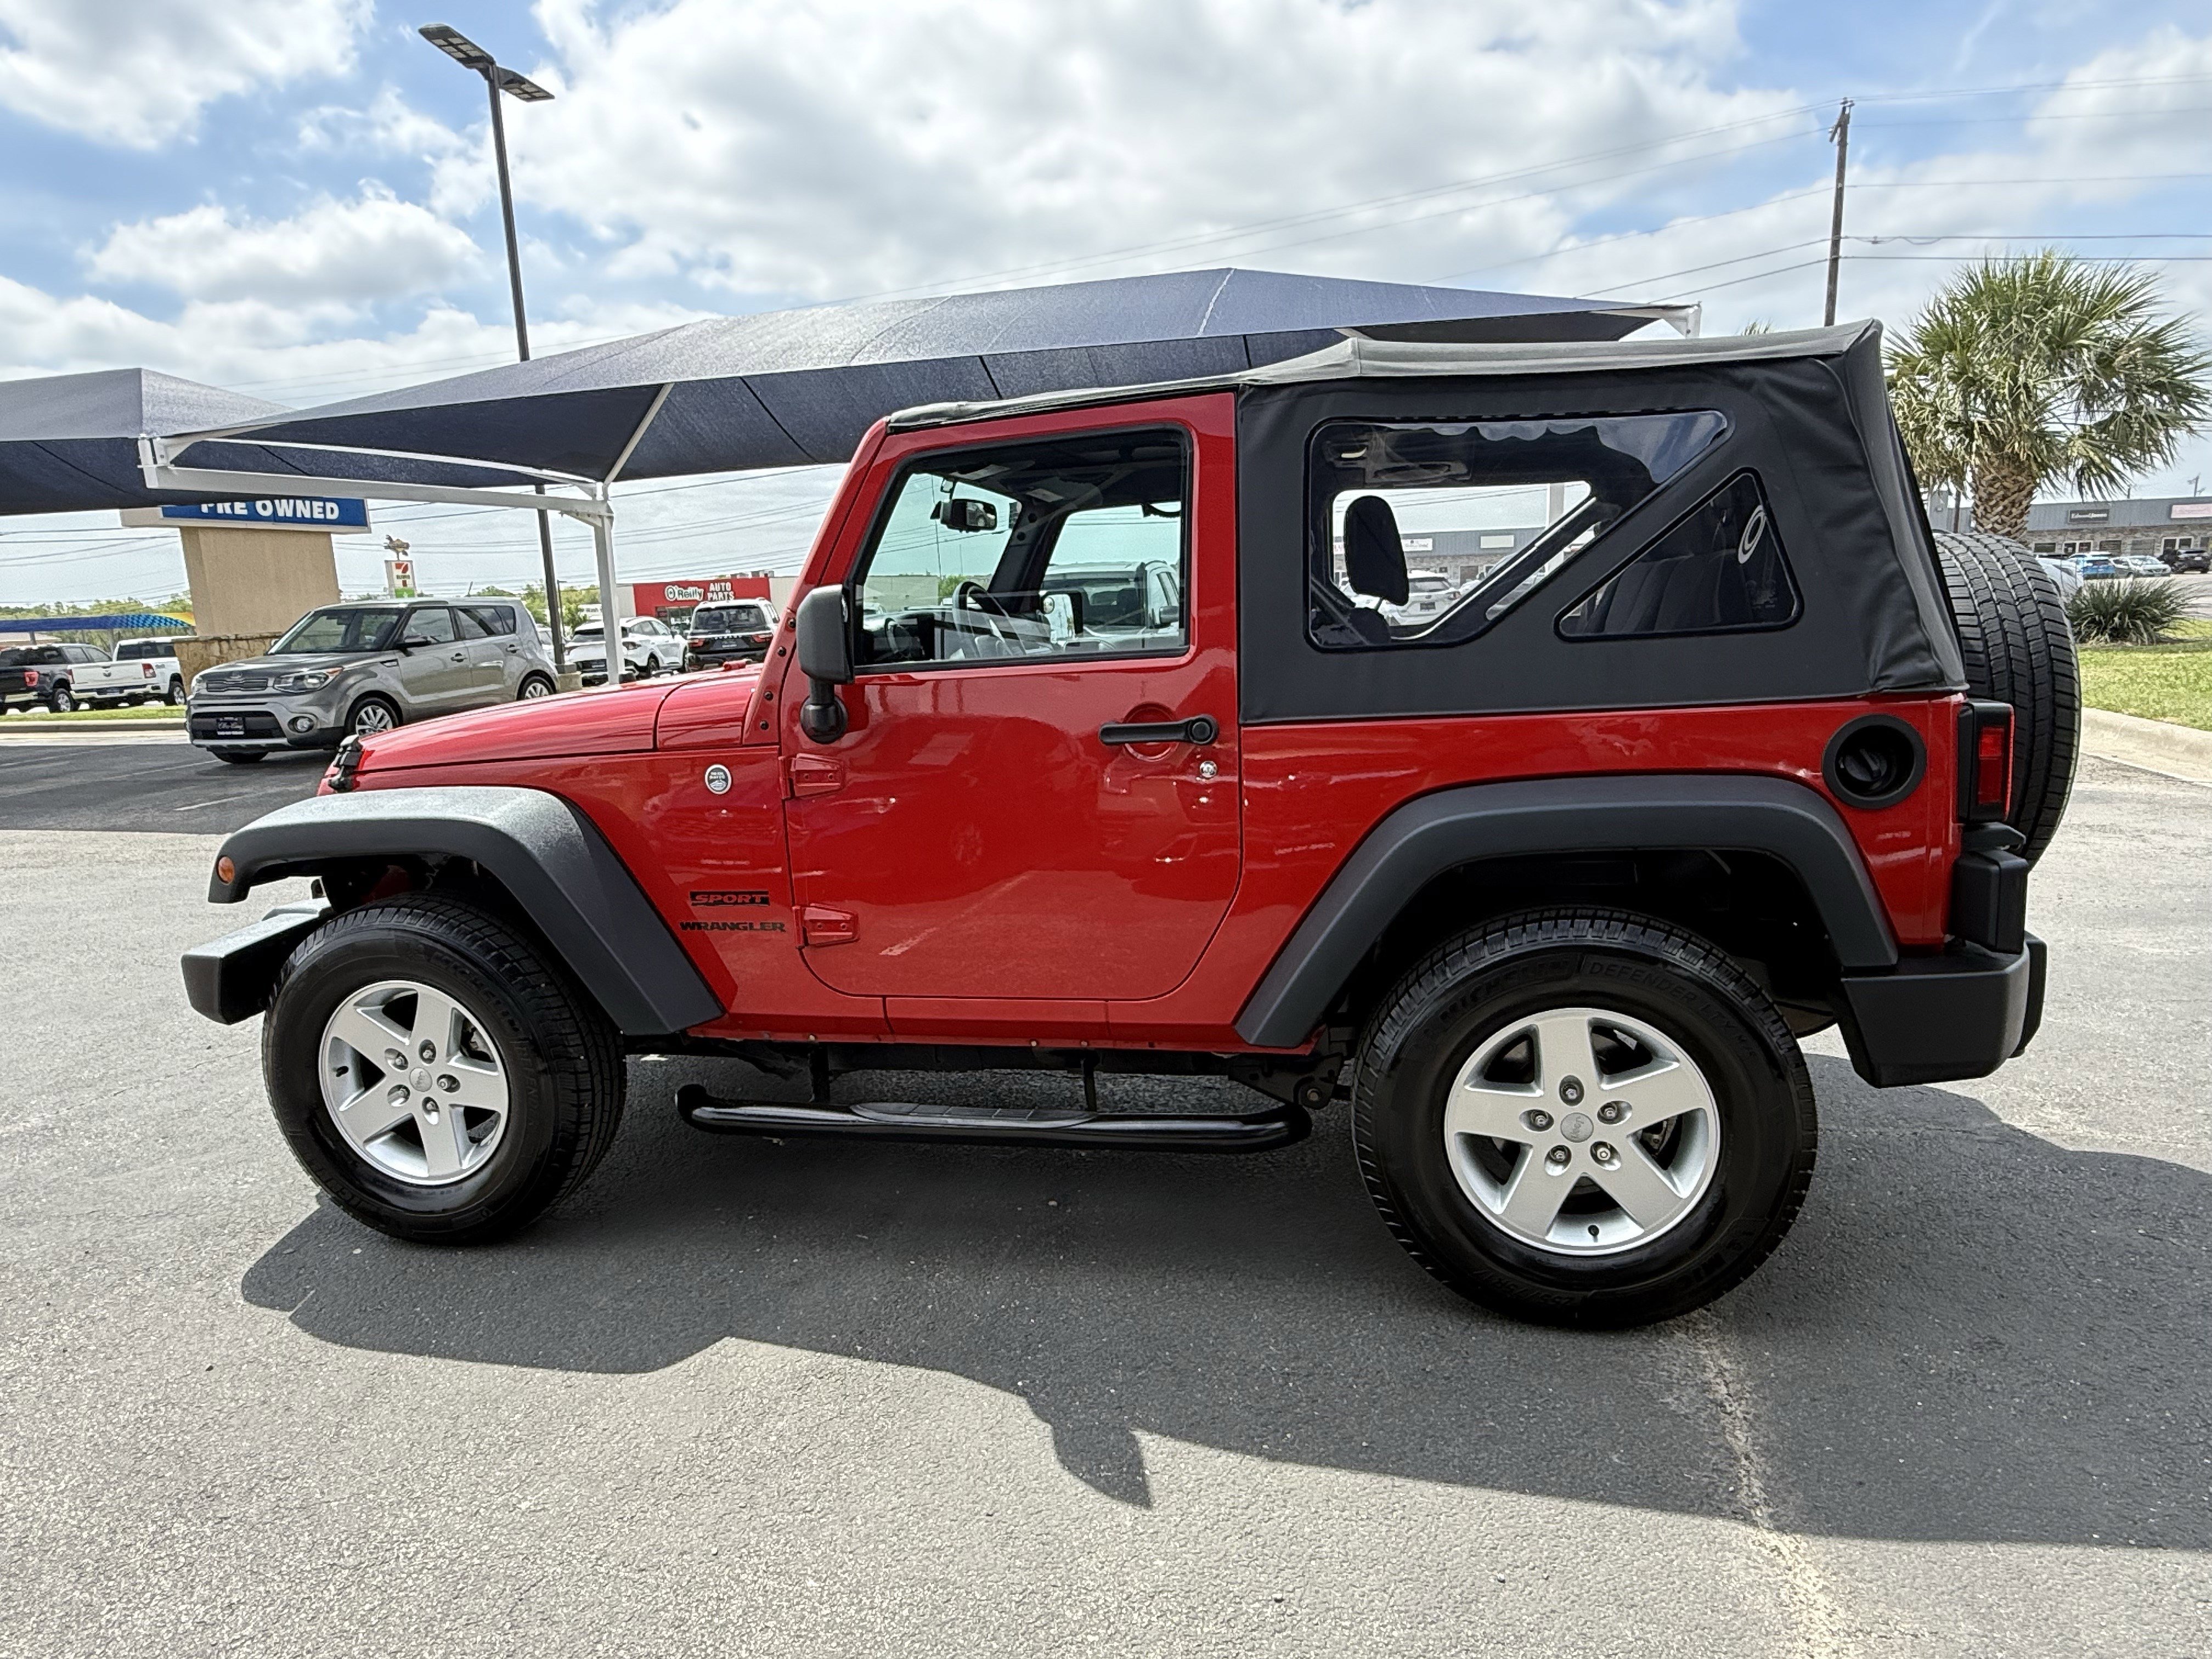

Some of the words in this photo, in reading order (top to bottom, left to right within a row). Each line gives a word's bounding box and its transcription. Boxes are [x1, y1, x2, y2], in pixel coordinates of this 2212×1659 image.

[255, 499, 339, 520] OWNED
[709, 582, 731, 591] AUTO
[665, 585, 704, 601] O'Reilly
[707, 591, 735, 601] PARTS
[696, 894, 769, 903] SPORT
[680, 922, 786, 932] WRANGLER
[1592, 962, 1698, 1003] DEFENDER
